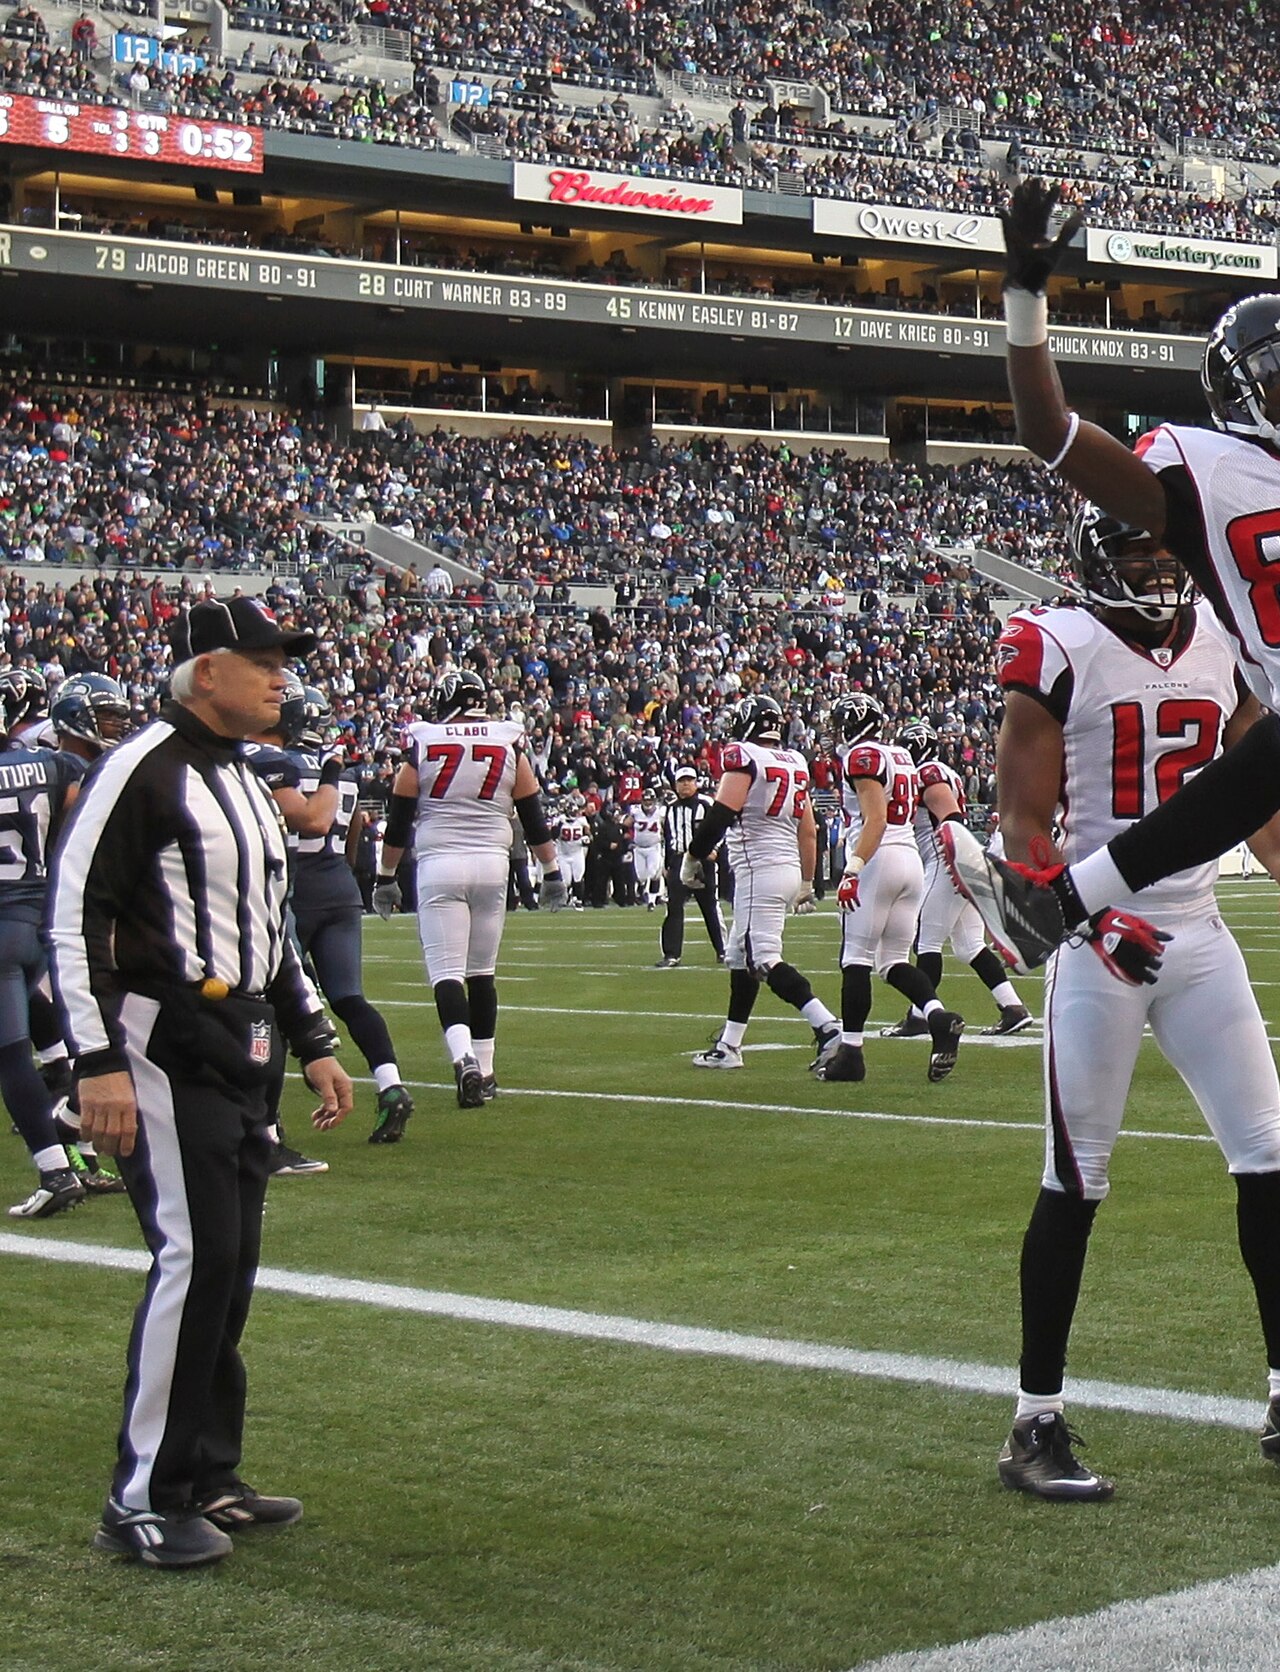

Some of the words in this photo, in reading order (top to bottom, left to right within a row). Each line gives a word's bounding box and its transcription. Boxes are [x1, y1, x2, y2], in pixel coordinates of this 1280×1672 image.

[123, 38, 151, 64] 12
[459, 84, 483, 105] 12
[48, 115, 69, 144] 5
[93, 122, 113, 135] TOL
[116, 110, 129, 130] 3
[137, 113, 168, 131] QTR
[115, 131, 128, 153] 3
[144, 130, 160, 156] 3
[182, 124, 254, 162] 0:52
[550, 169, 715, 214] Budweiser
[858, 207, 946, 242] Qwest
[95, 246, 126, 271] 79
[136, 252, 189, 276] JACOB
[196, 258, 250, 282] GREEN
[1134, 242, 1263, 270] walottery.com
[359, 273, 386, 296] 28
[393, 278, 433, 300] CURT
[441, 282, 502, 306] WARNER
[606, 297, 632, 319] 45
[639, 300, 685, 322] KENNY
[692, 304, 745, 327] EASLEY
[750, 310, 799, 332] 81-87
[834, 317, 853, 338] 17
[860, 320, 893, 341] DAVE
[899, 324, 937, 344] KRIEG
[1048, 336, 1090, 357] CHUCK
[1091, 340, 1124, 359] KNOX
[1145, 682, 1189, 690] FALCONS
[445, 726, 488, 737] CLABO
[427, 743, 508, 801] 77
[1111, 698, 1222, 820] 12
[0, 762, 47, 790] TUPU
[625, 777, 640, 790] 33
[765, 766, 810, 819] 72
[0, 792, 51, 881] 51
[561, 827, 582, 842] 95
[640, 822, 659, 835] 74
